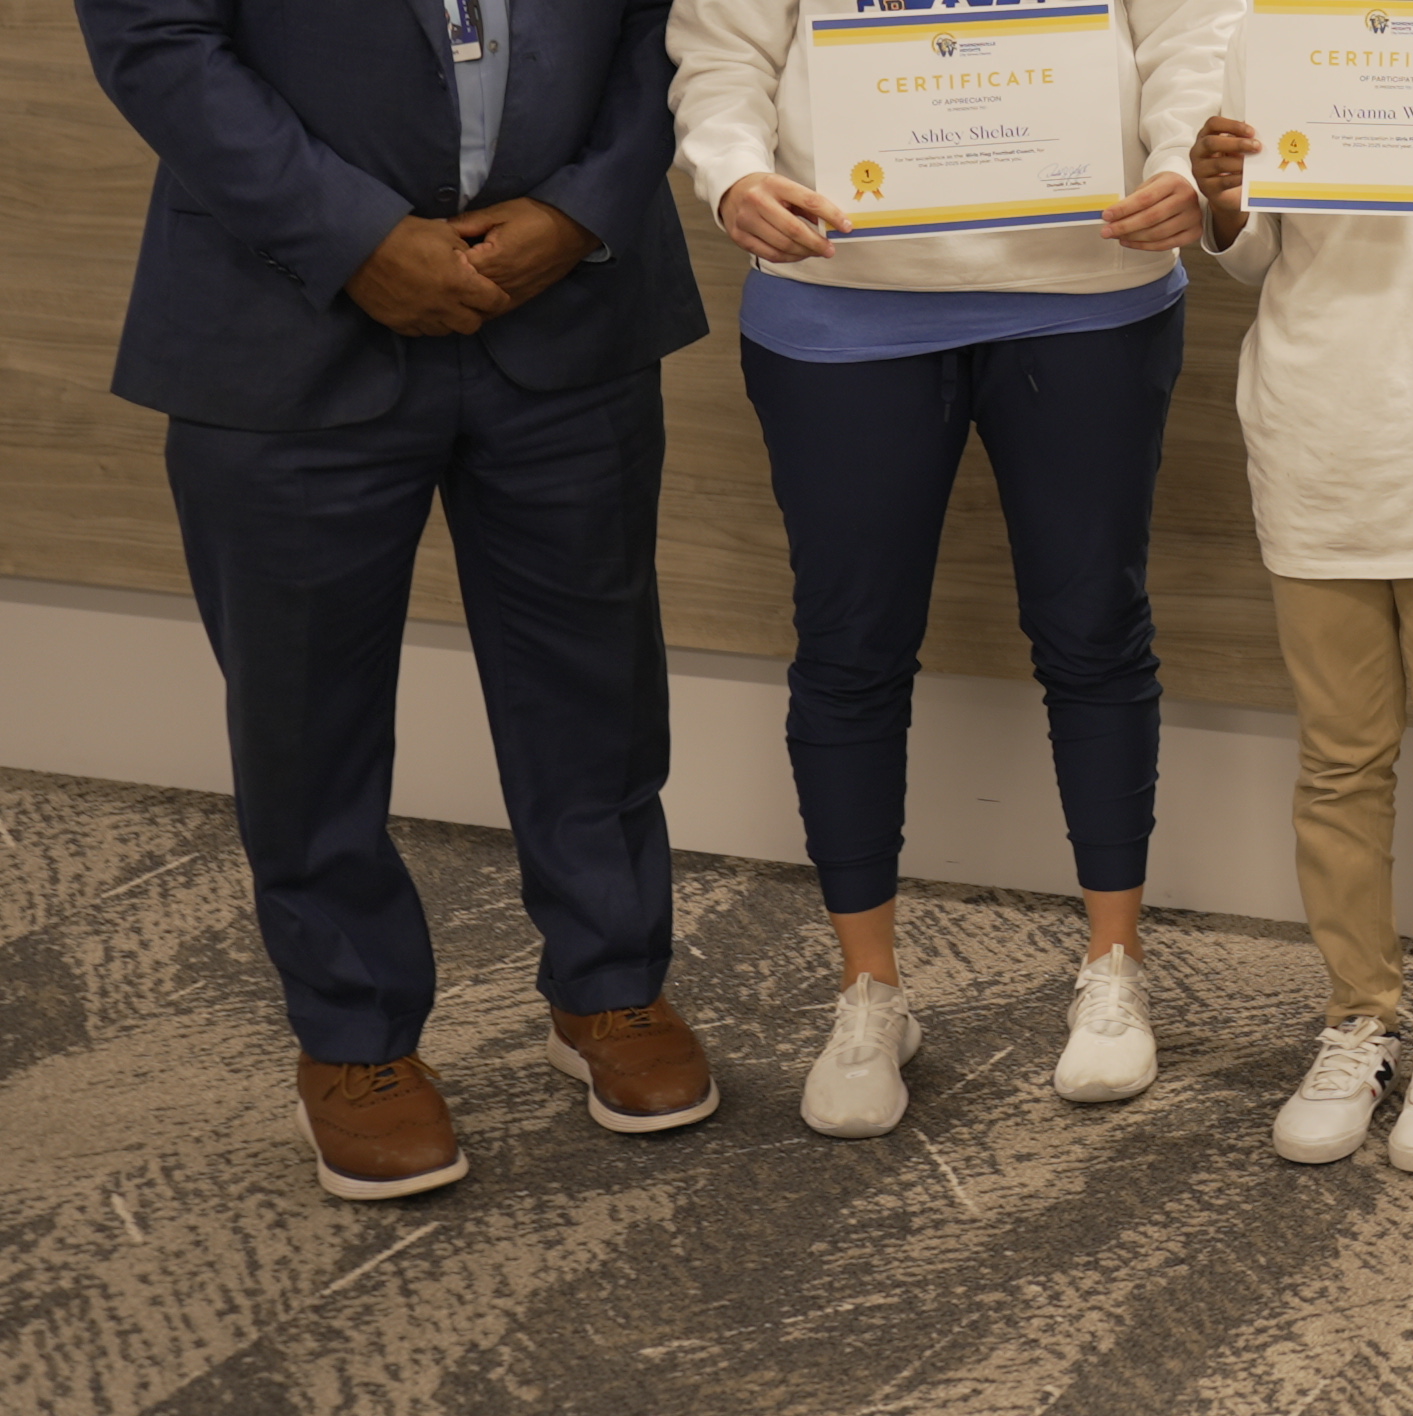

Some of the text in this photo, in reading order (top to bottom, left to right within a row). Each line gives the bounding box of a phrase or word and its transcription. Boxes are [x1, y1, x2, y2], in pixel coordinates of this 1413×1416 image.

[876, 68, 1055, 94] CERTIFICATE
[945, 95, 1002, 105] APPRECIATION
[1329, 104, 1397, 122] Aiyanna
[908, 124, 1030, 145] Ashley Shelatz
